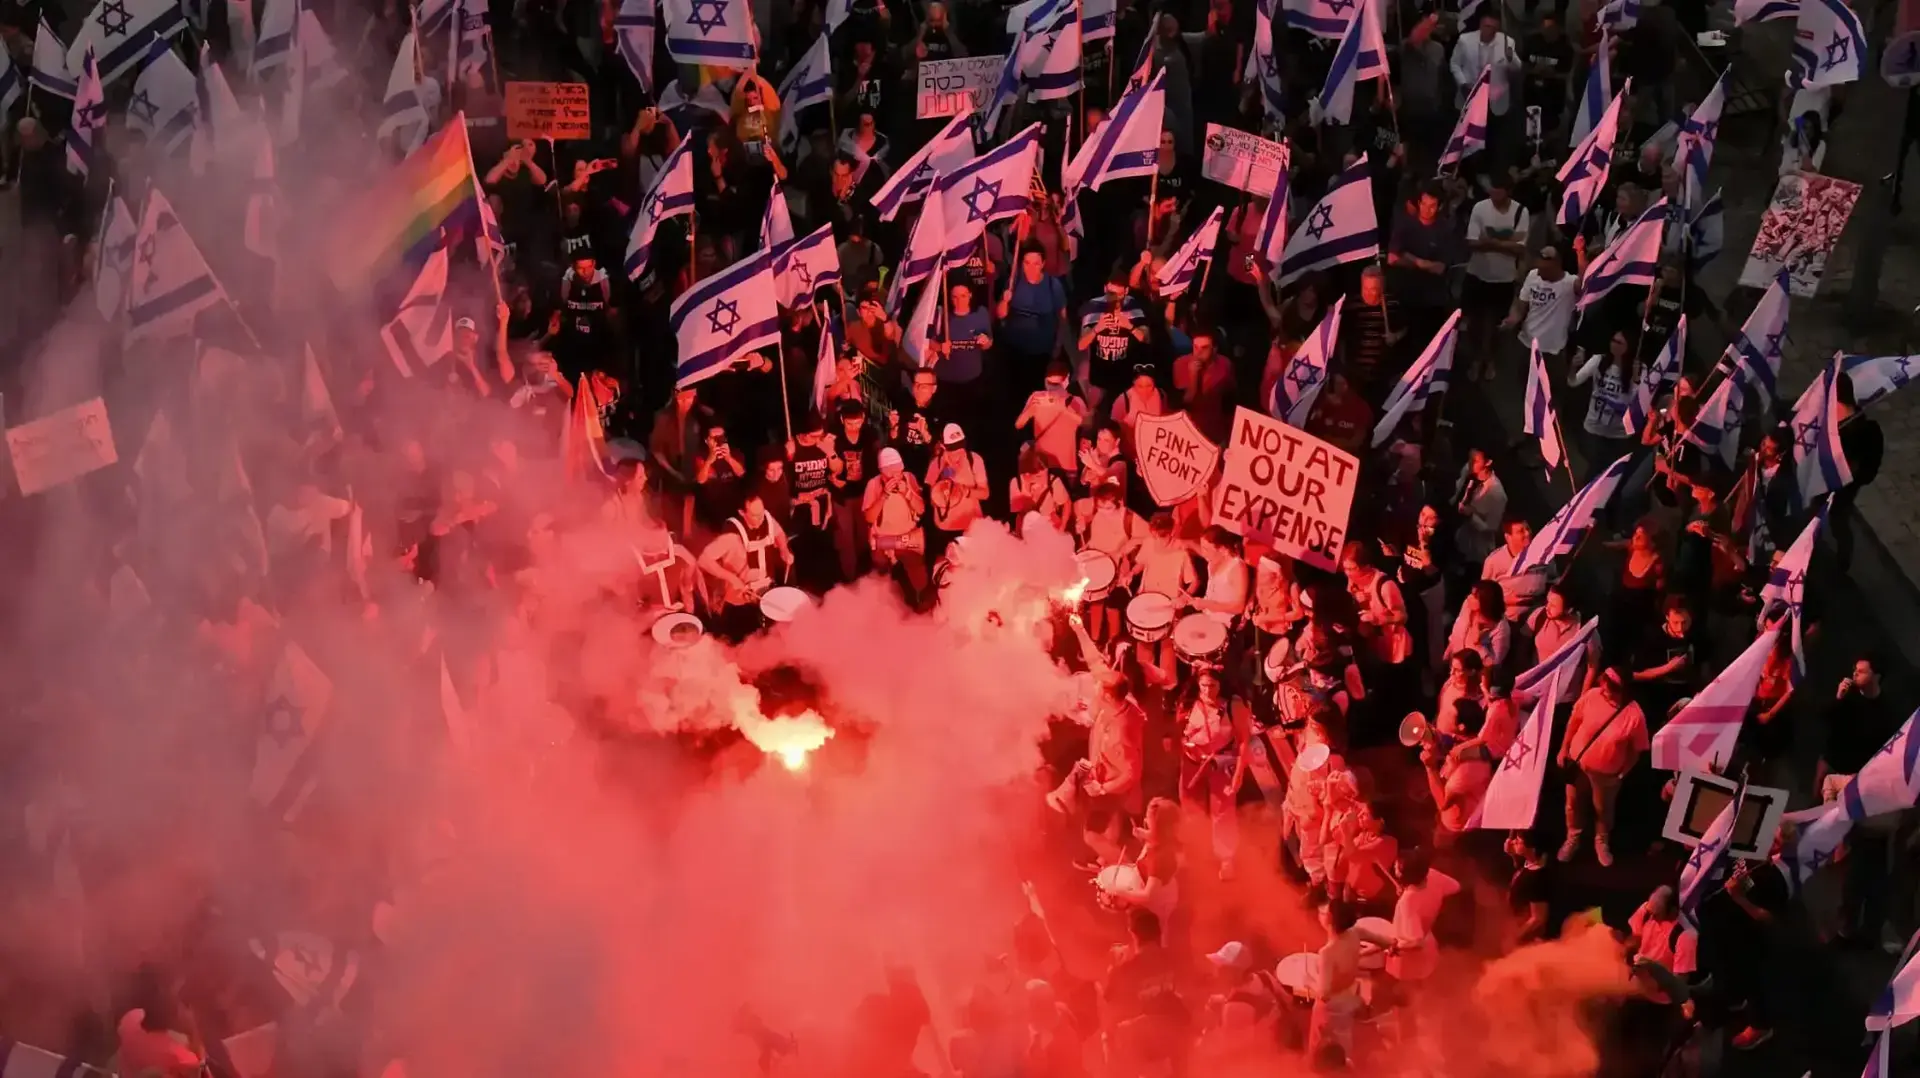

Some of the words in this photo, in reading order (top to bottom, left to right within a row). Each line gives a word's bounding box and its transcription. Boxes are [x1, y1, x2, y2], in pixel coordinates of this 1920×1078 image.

[925, 75, 966, 96] כסף
[1096, 335, 1129, 348] חופשי
[1155, 426, 1199, 461] PINK
[1240, 418, 1303, 463] NOT
[1305, 446, 1354, 487] AT
[1147, 445, 1202, 485] FRONT
[1249, 454, 1326, 514] OUR
[1219, 483, 1343, 561] EXPENSE
